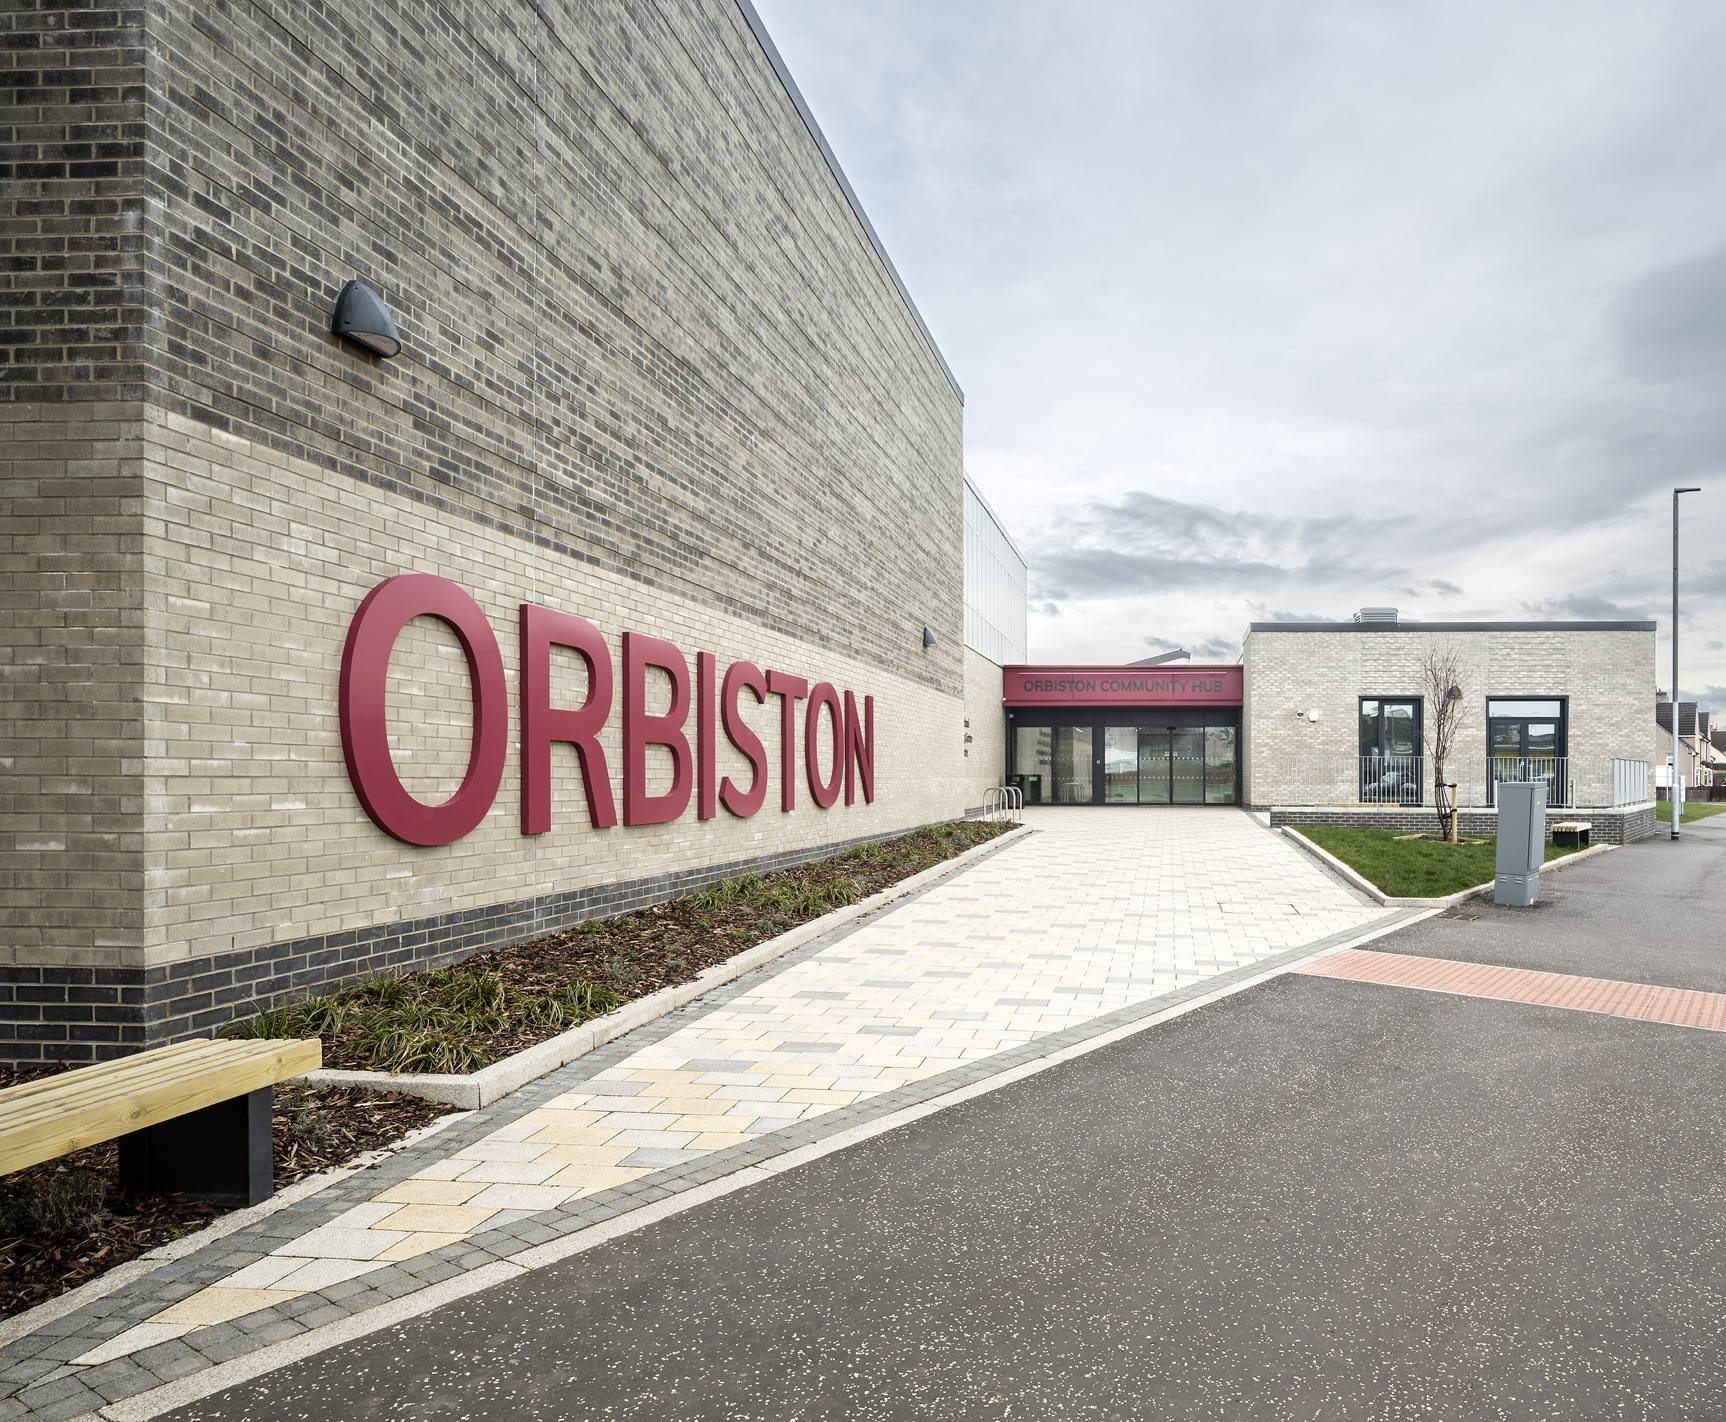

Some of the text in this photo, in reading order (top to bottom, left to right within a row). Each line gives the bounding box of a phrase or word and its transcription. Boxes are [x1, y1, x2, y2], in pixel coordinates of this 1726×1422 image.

[339, 573, 874, 847] ORBISTON
[1023, 679, 1223, 692] ORBISTON COMMUNITY HUB
